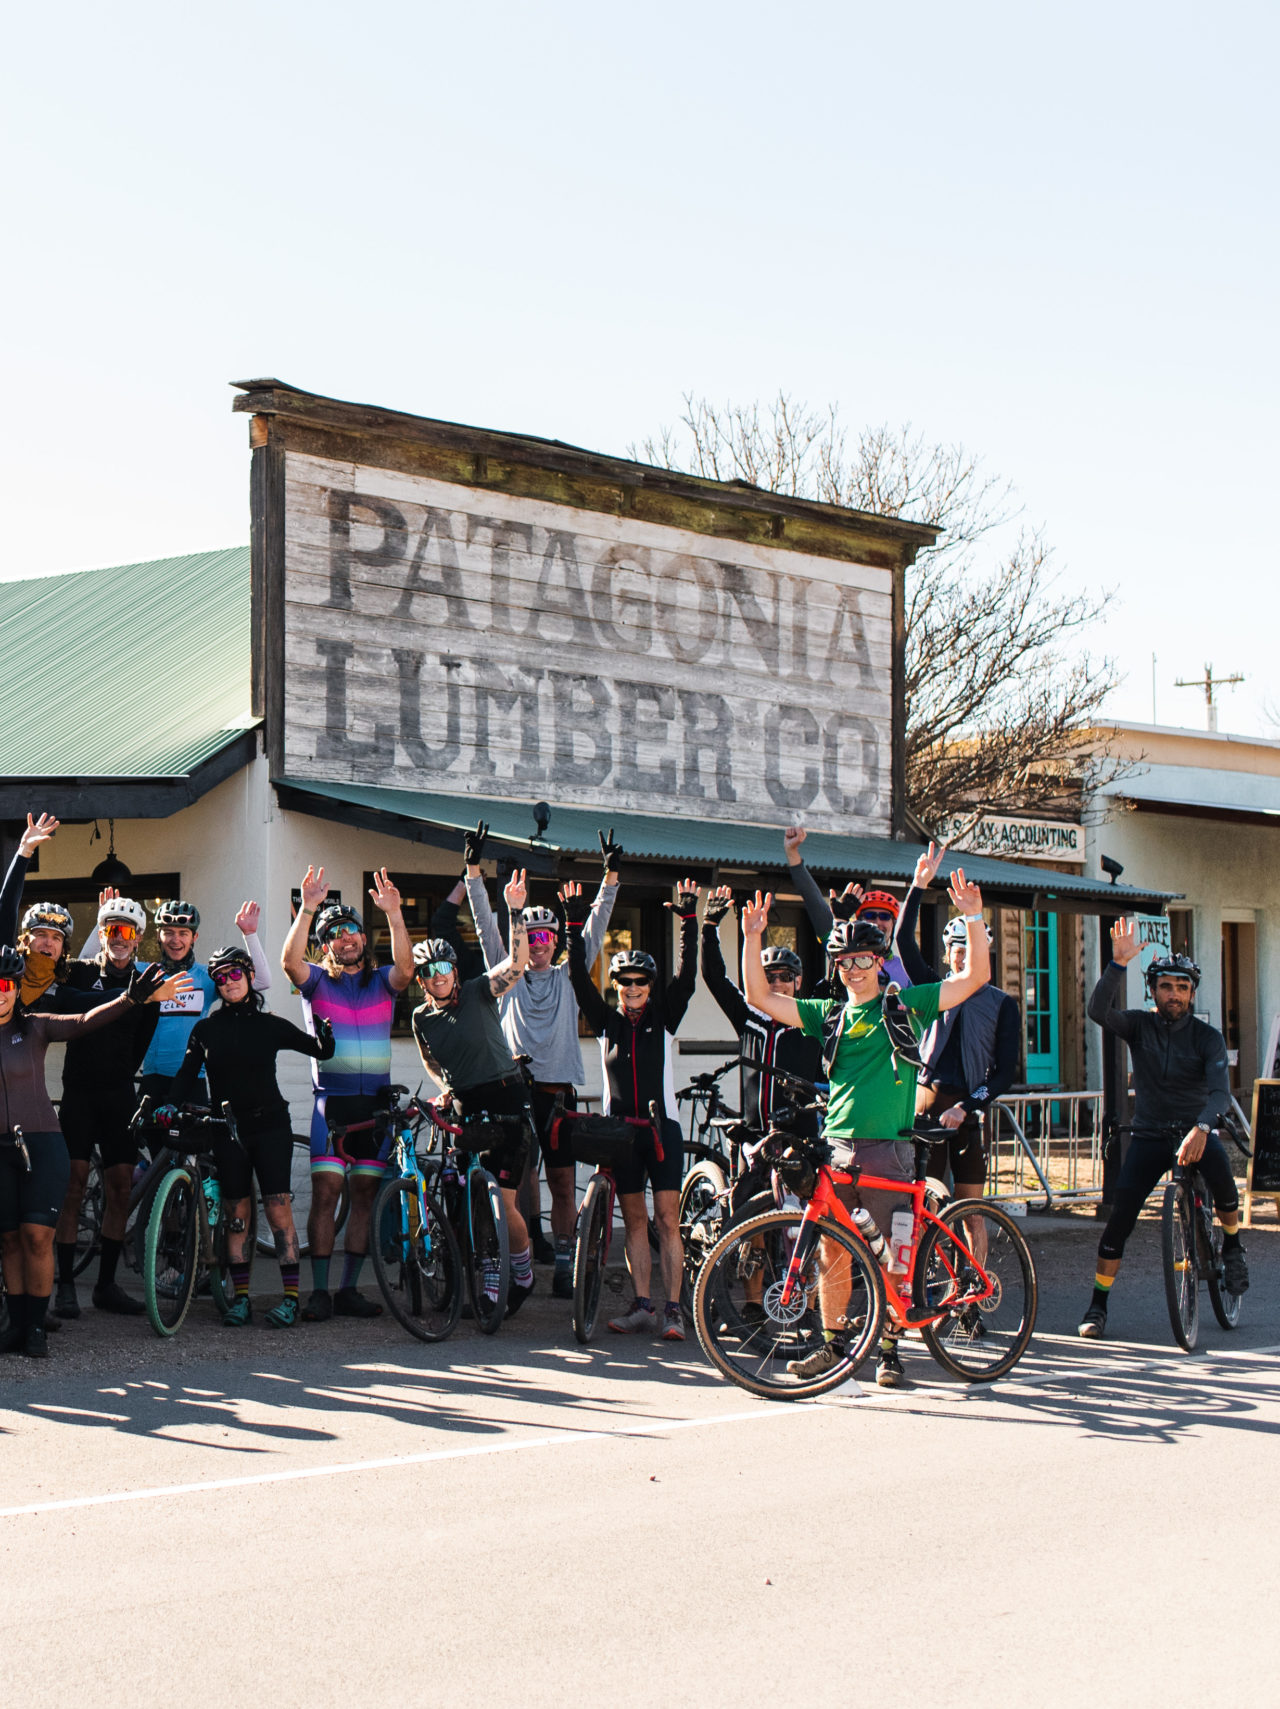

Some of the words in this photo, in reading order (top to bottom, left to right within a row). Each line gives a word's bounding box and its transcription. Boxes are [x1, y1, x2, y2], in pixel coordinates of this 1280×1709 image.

[320, 488, 883, 692] PATAGONIA
[315, 637, 737, 803] LUMBER
[1001, 823, 1077, 849] ACCOUNTING
